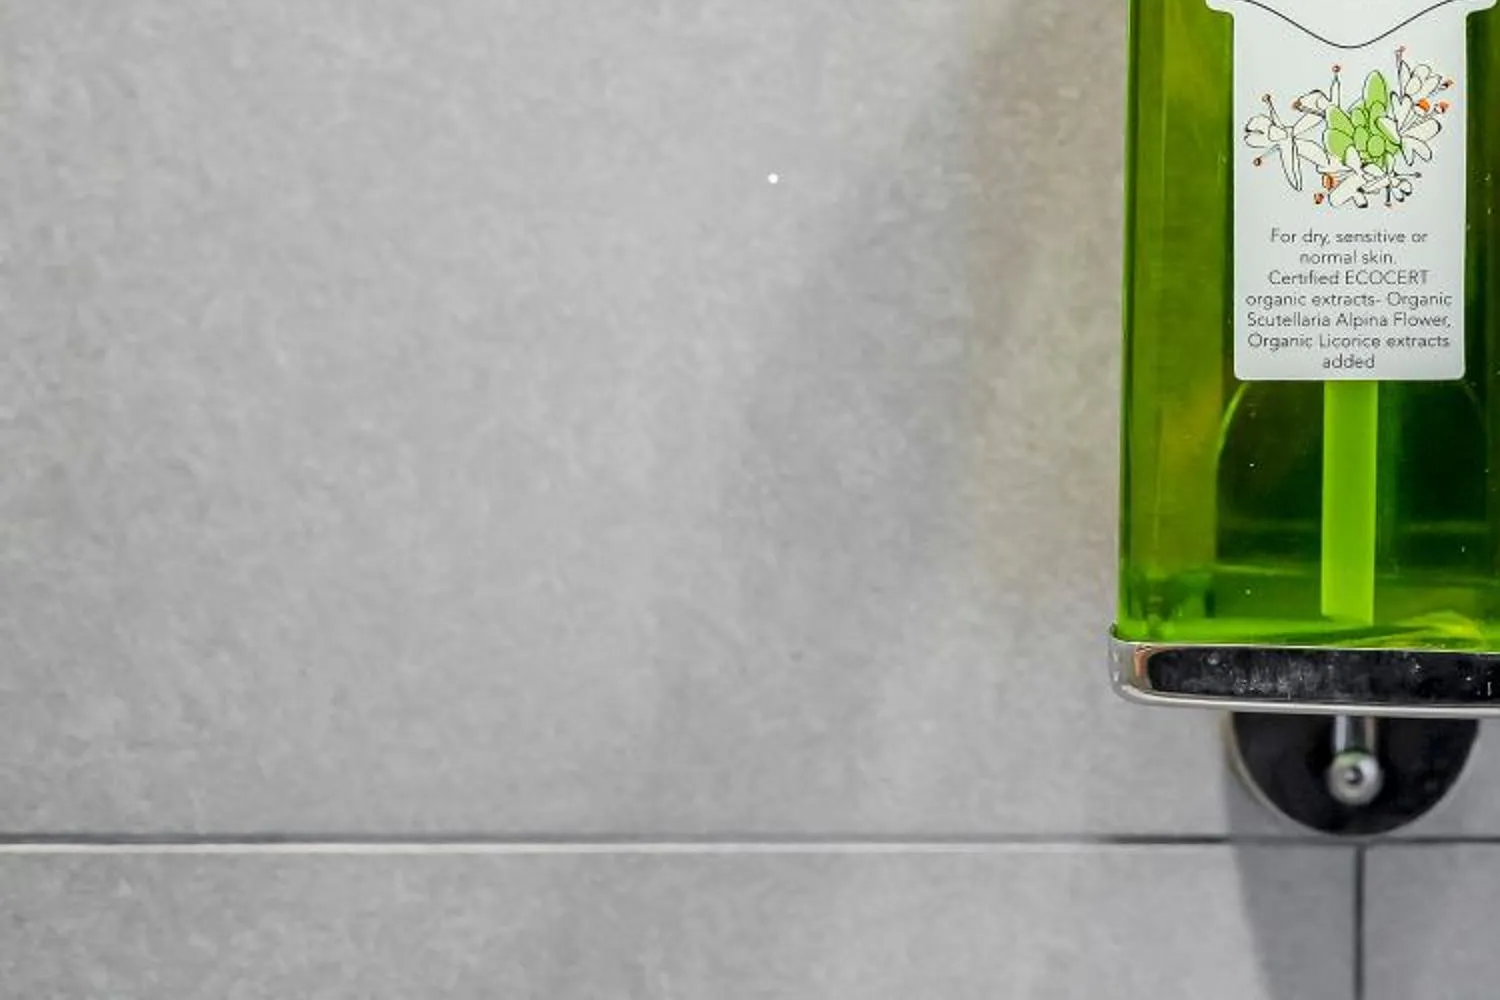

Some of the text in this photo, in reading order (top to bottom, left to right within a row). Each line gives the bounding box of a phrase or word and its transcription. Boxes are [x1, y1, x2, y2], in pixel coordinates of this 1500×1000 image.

[1270, 227, 1428, 247] For dry, sensitive or
[1300, 249, 1397, 265] normal skin.
[1268, 269, 1430, 285] Certified ECOCERT
[1245, 292, 1453, 310] organic extracts- Organic
[1247, 312, 1451, 330] Scutellaria Alpina Flower,
[1247, 332, 1450, 350] Organic Licorice extracts
[1322, 353, 1375, 369] added
